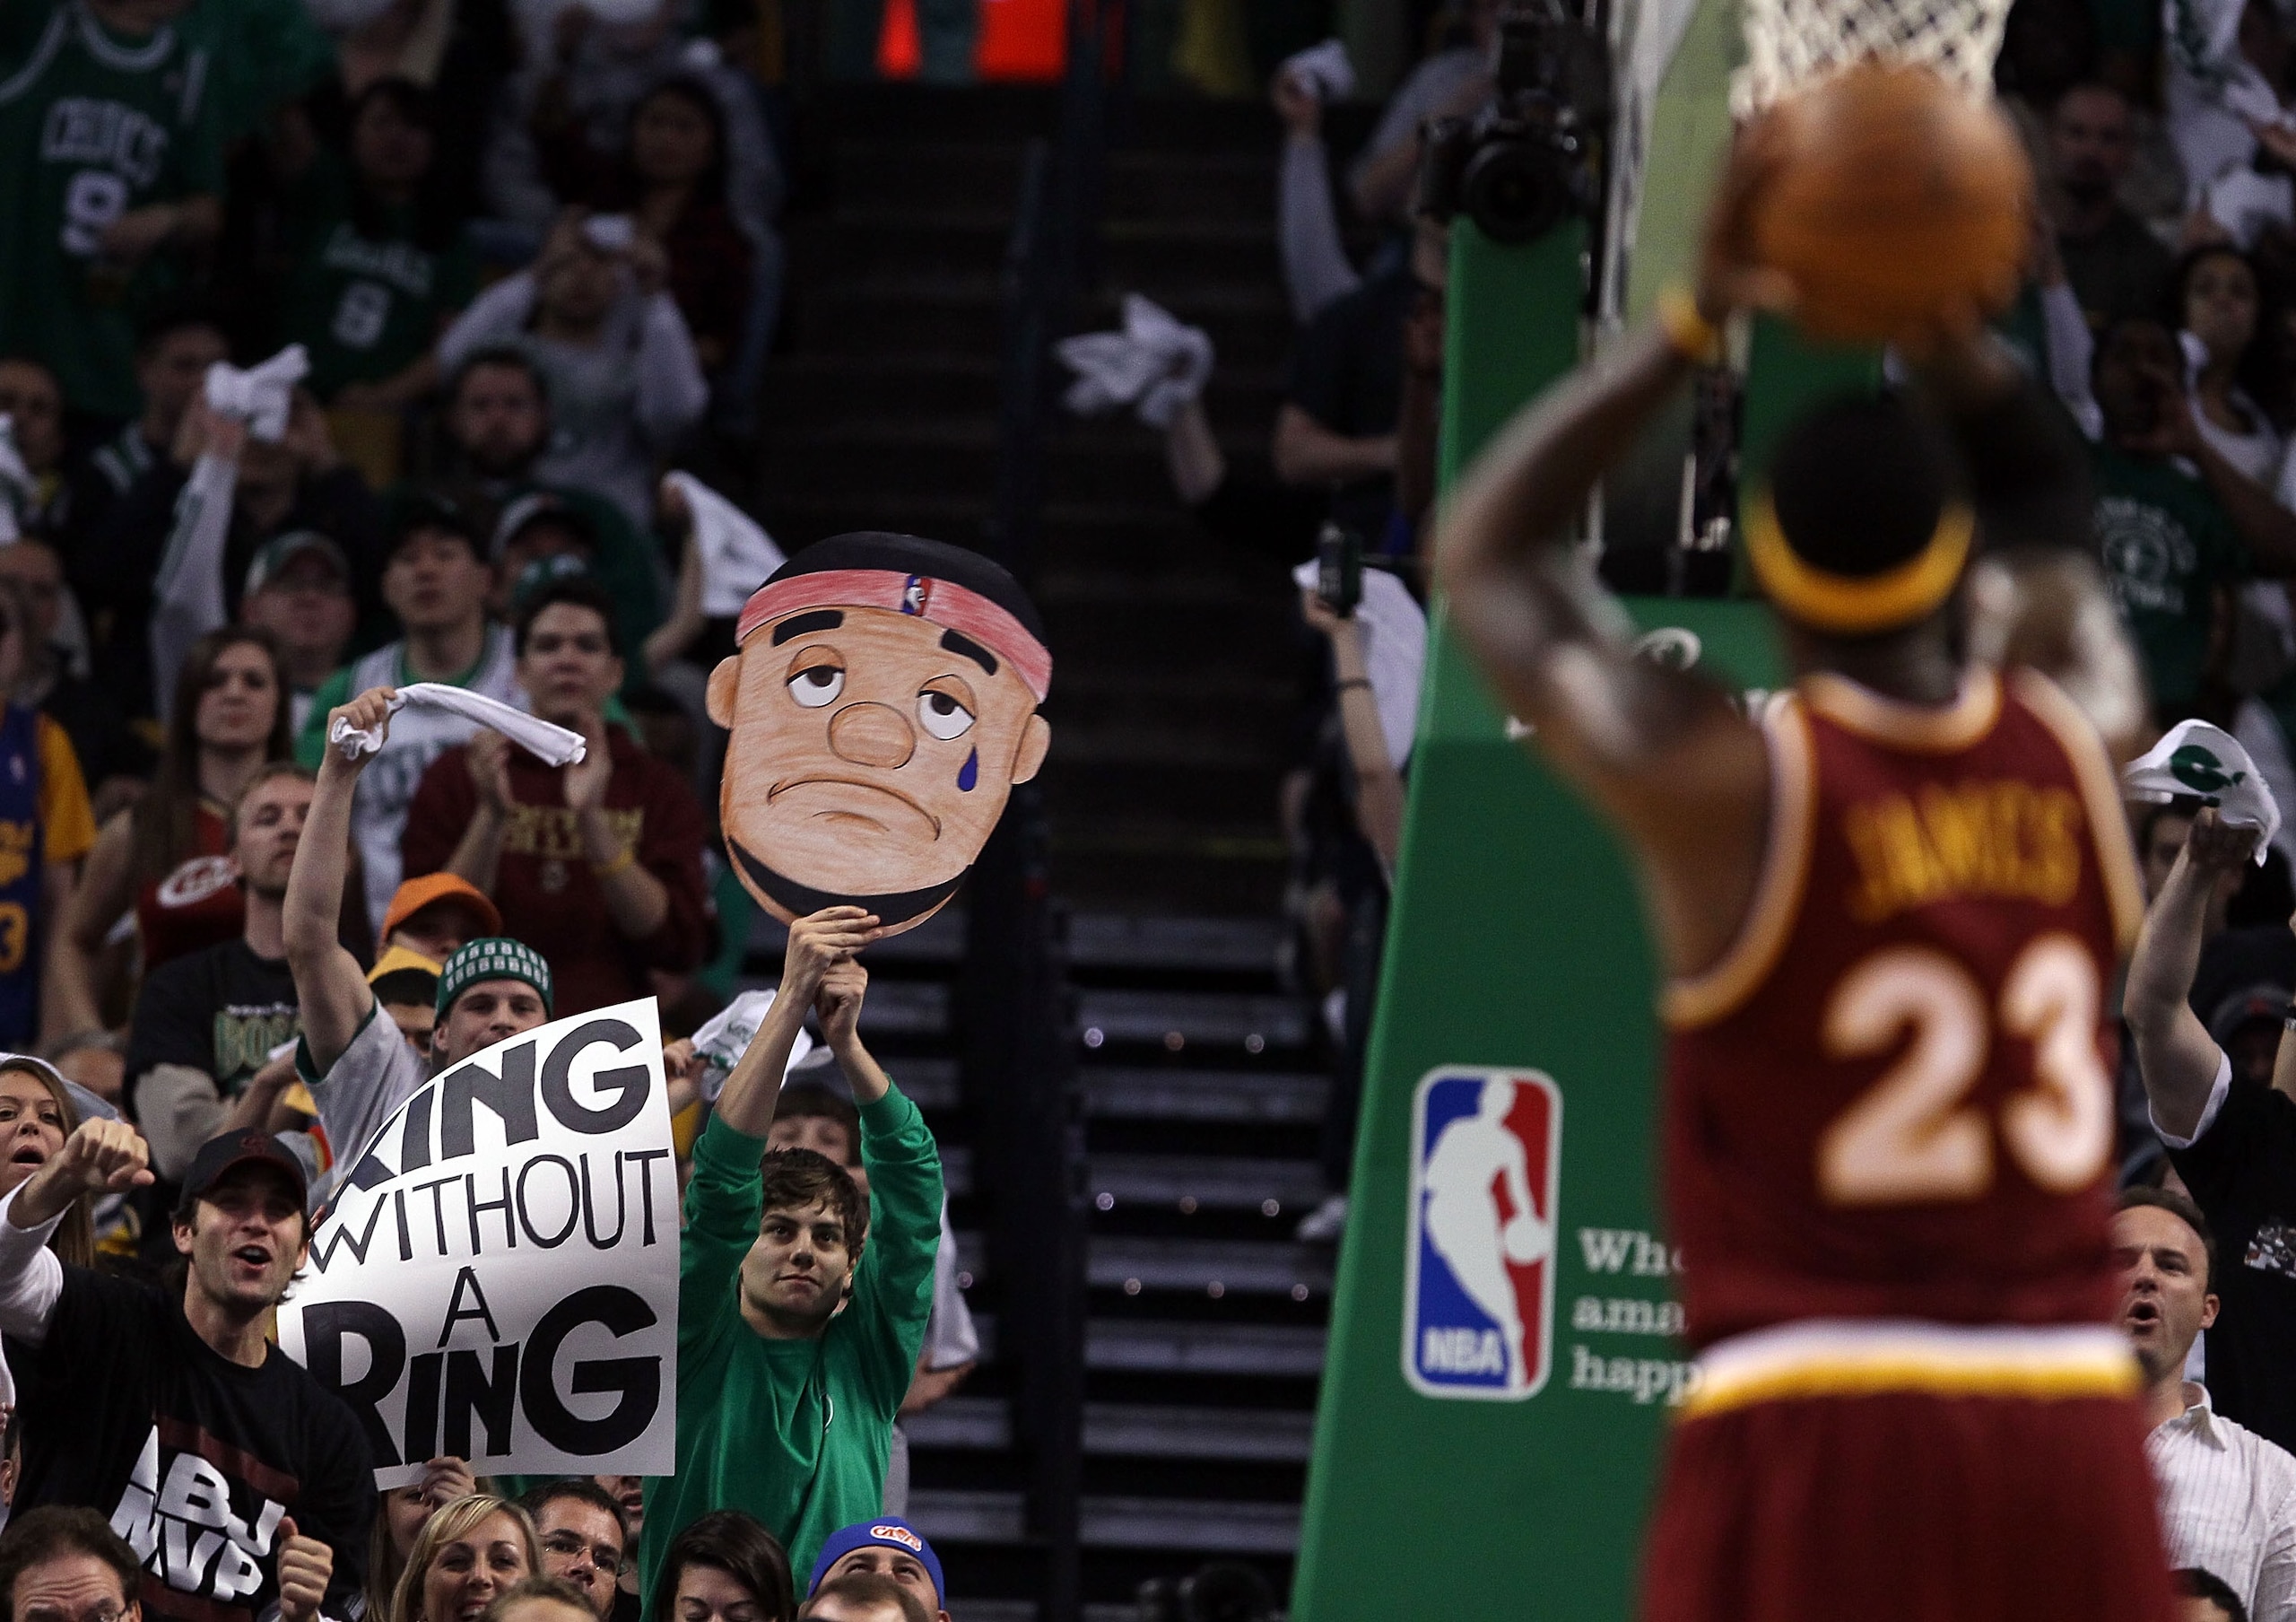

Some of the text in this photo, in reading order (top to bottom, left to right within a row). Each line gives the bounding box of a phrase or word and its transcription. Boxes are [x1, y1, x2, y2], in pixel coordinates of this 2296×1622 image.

[1813, 929, 2118, 1211] 23
[309, 1148, 669, 1273] WITHOUT
[437, 1266, 500, 1347] A
[1421, 1326, 1503, 1375] NBA
[301, 1285, 663, 1467] RING
[109, 1482, 264, 1602] MVP
